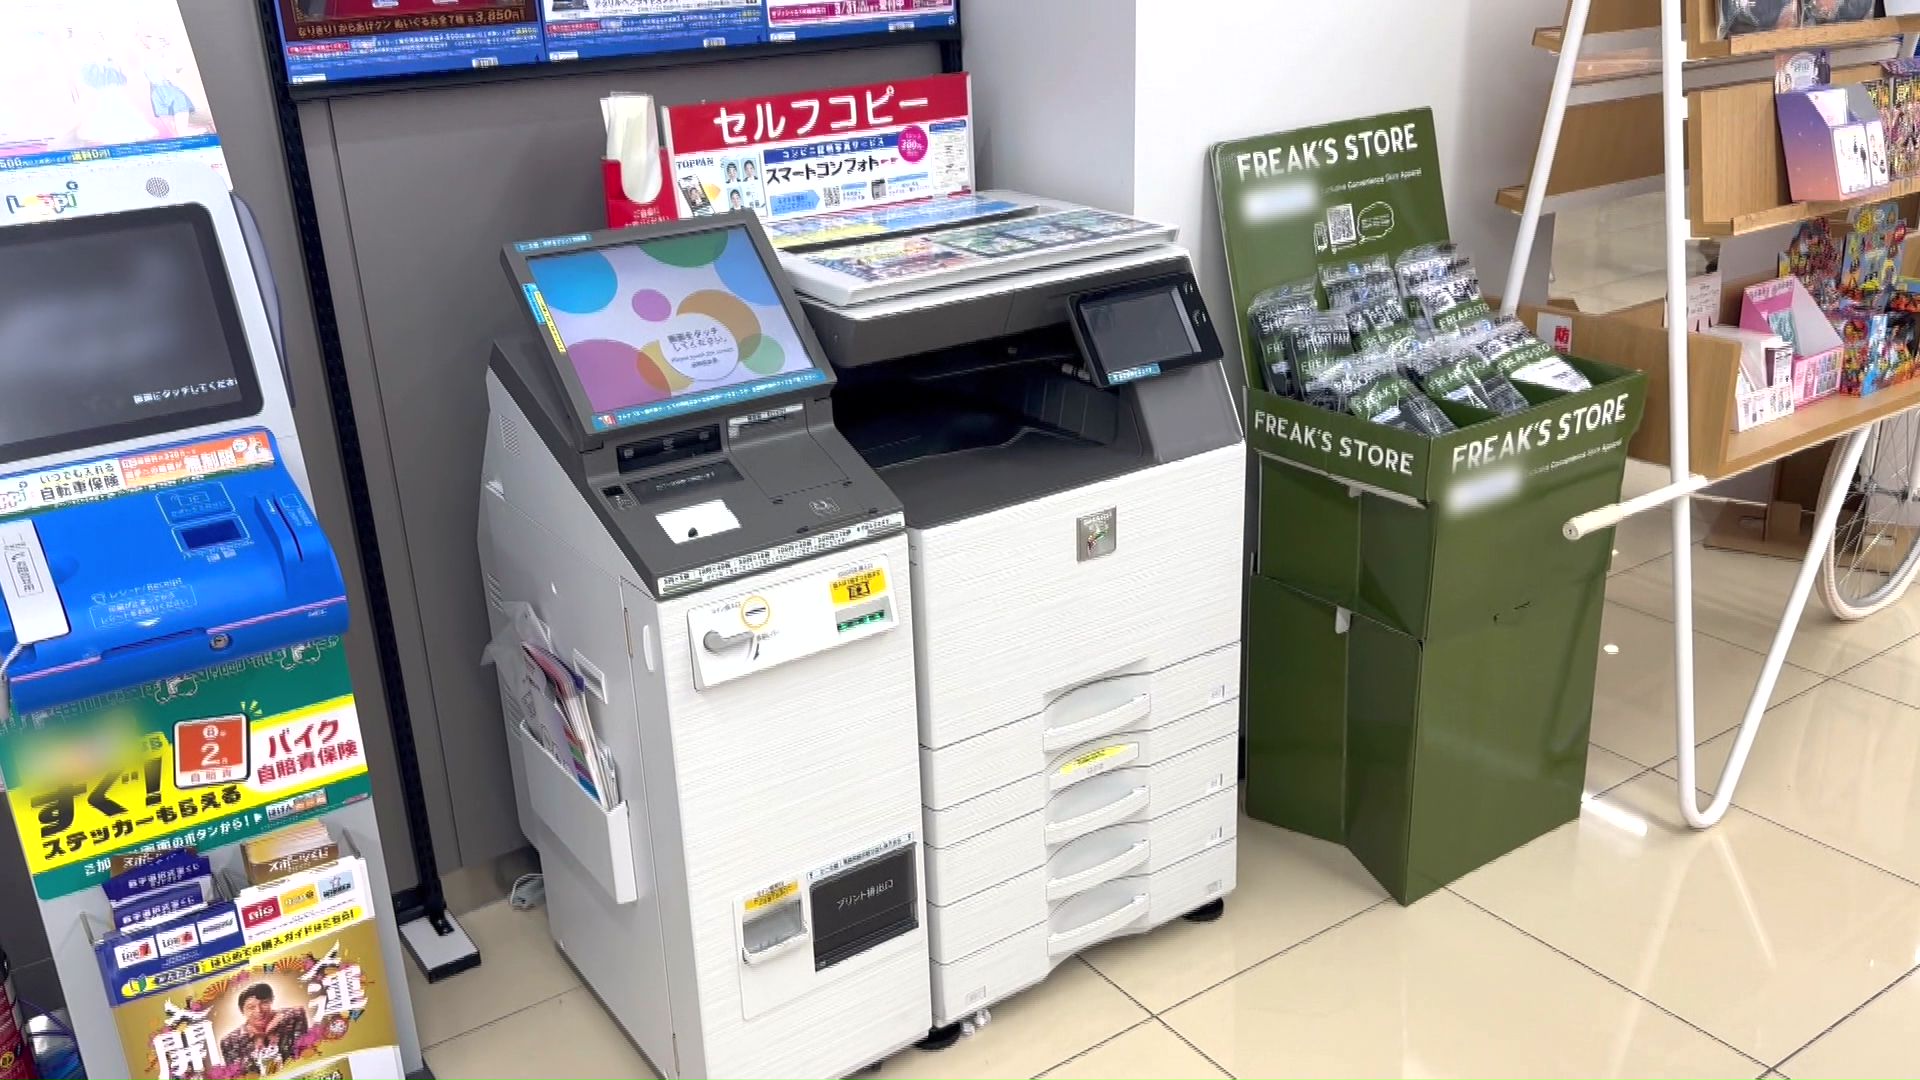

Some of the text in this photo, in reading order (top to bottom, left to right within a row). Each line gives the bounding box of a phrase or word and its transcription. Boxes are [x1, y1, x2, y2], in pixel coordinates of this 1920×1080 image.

[713, 84, 929, 145] セルフコピー
[676, 157, 714, 168] TOPPAN
[782, 135, 885, 158] コンビニ証明写真サービス
[1237, 123, 1419, 182] FREAK'S STORE
[1254, 409, 1414, 477] FREAK'S STORE
[1451, 393, 1630, 475] FREAK'S STORE
[40, 472, 121, 502] 自転車保険
[256, 739, 359, 785] 自賠責保険
[268, 719, 340, 759] バイク
[43, 784, 242, 861] ステッカーもらえる
[836, 878, 894, 911] プリント排出口
